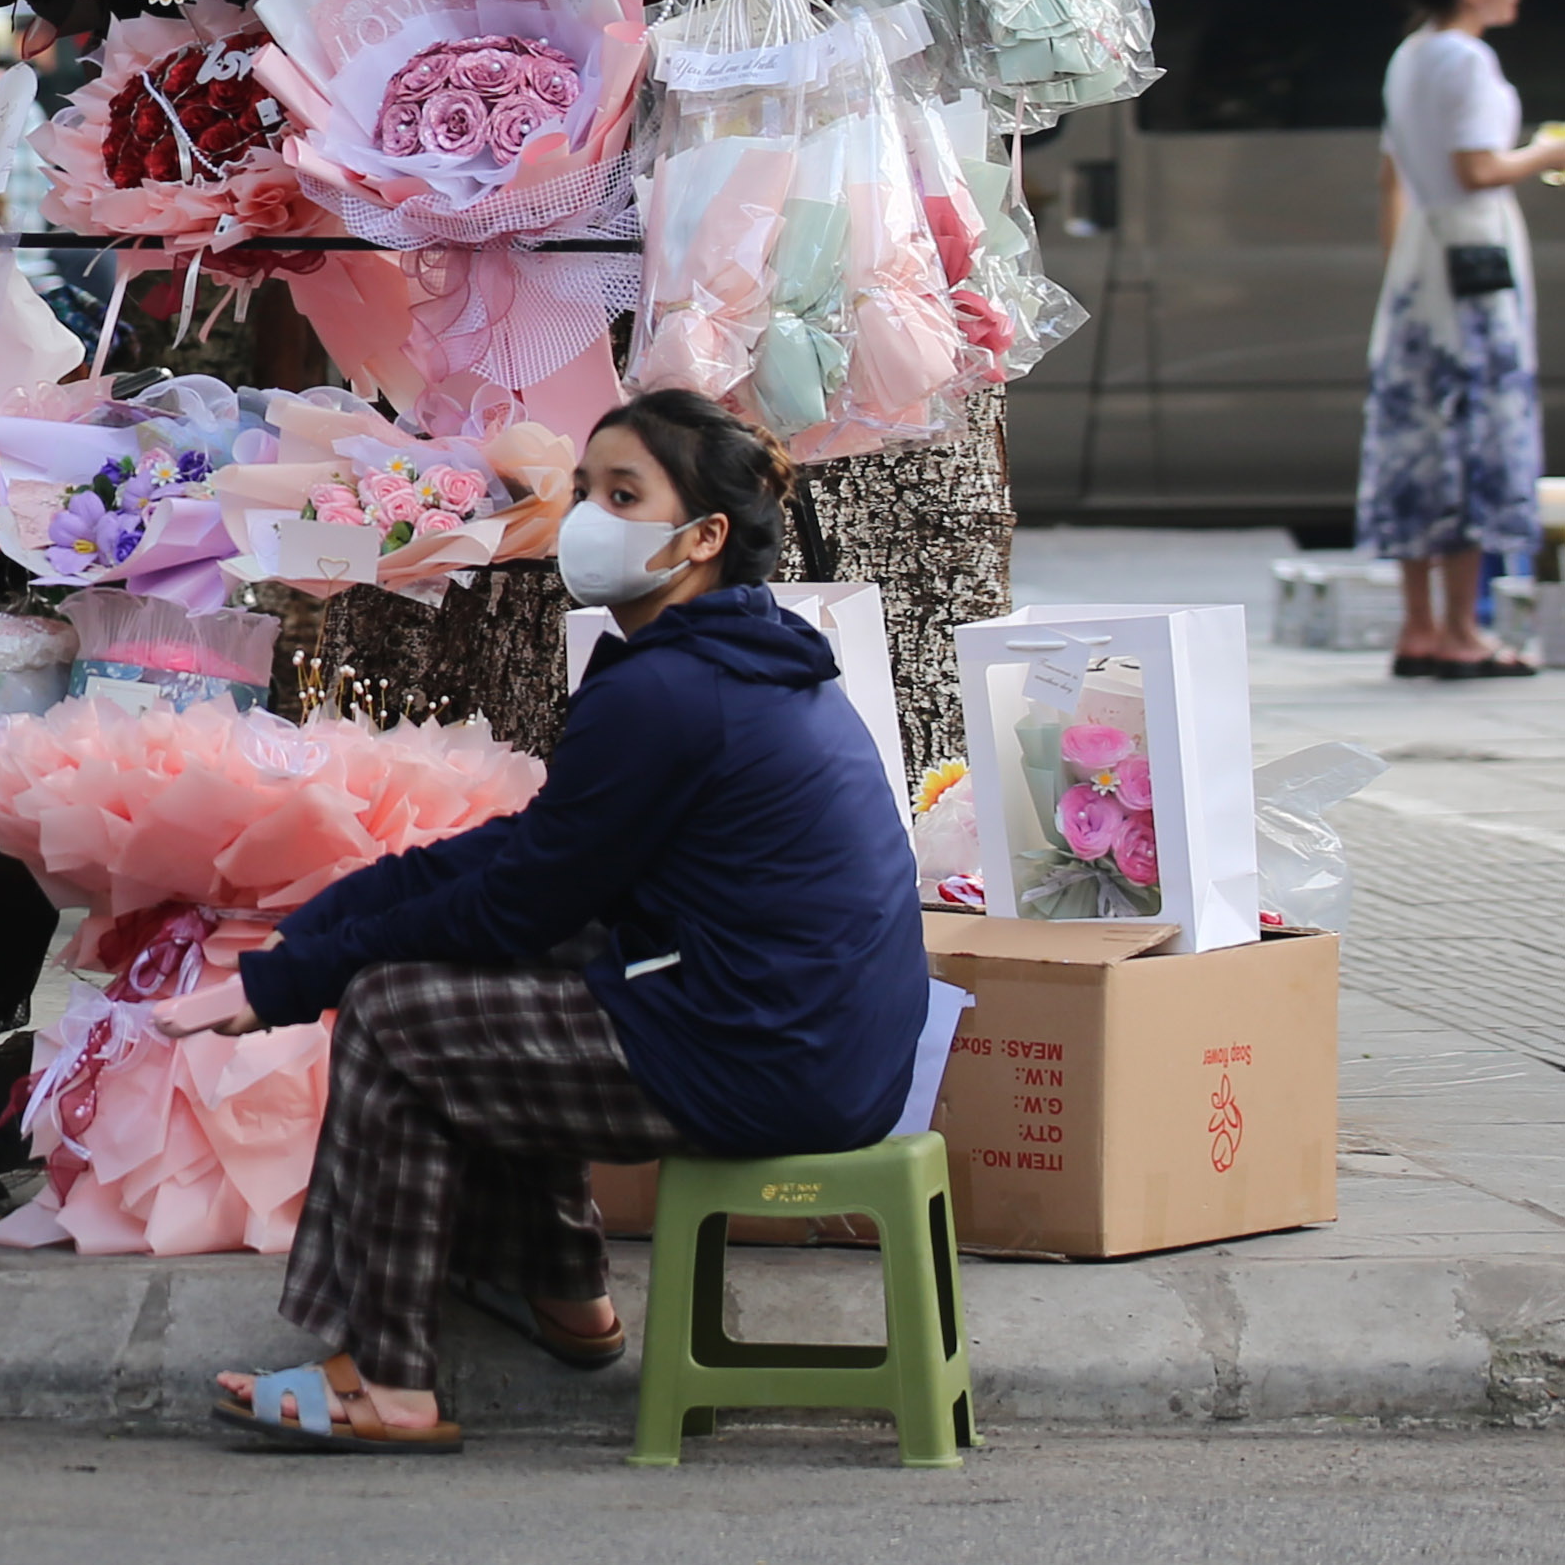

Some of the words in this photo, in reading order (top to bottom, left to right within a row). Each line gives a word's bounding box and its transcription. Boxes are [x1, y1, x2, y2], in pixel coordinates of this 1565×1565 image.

[1001, 1039, 1063, 1061] MEAS:
[1231, 1042, 1253, 1066] Soap
[1015, 1067, 1063, 1087] N.W.:
[1014, 1095, 1063, 1115] G.W.:
[1018, 1123, 1063, 1143] QTY:
[971, 1148, 1012, 1168] NO.:
[1017, 1151, 1063, 1172] ITEM
